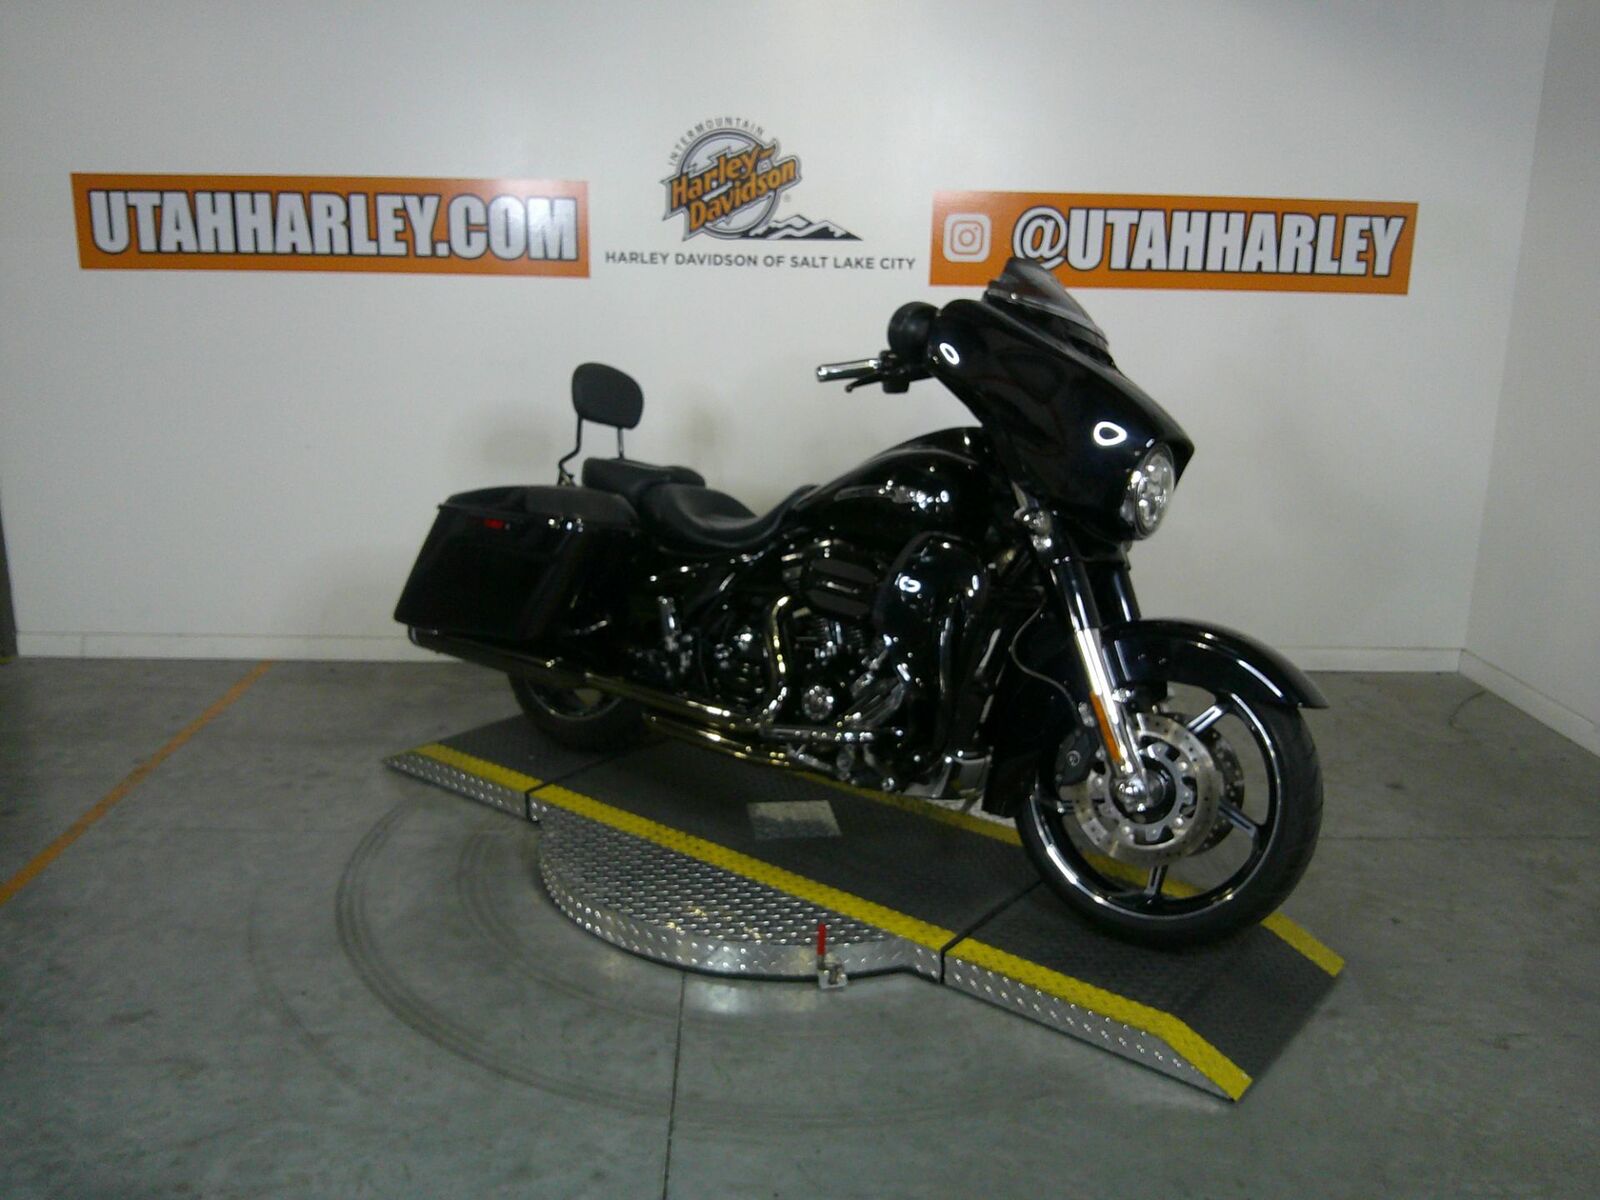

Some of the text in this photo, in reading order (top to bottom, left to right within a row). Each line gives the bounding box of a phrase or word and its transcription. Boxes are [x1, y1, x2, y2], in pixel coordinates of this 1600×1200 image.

[668, 117, 764, 167] INTERMOUNTAIN
[88, 189, 579, 262] UTAHHARLEY.COM
[688, 158, 797, 232] Davidson
[605, 251, 916, 270] HARLEY DAVIDSON OF SALT LAKE CITY
[1011, 205, 1406, 277] @UTAHHARLEY
